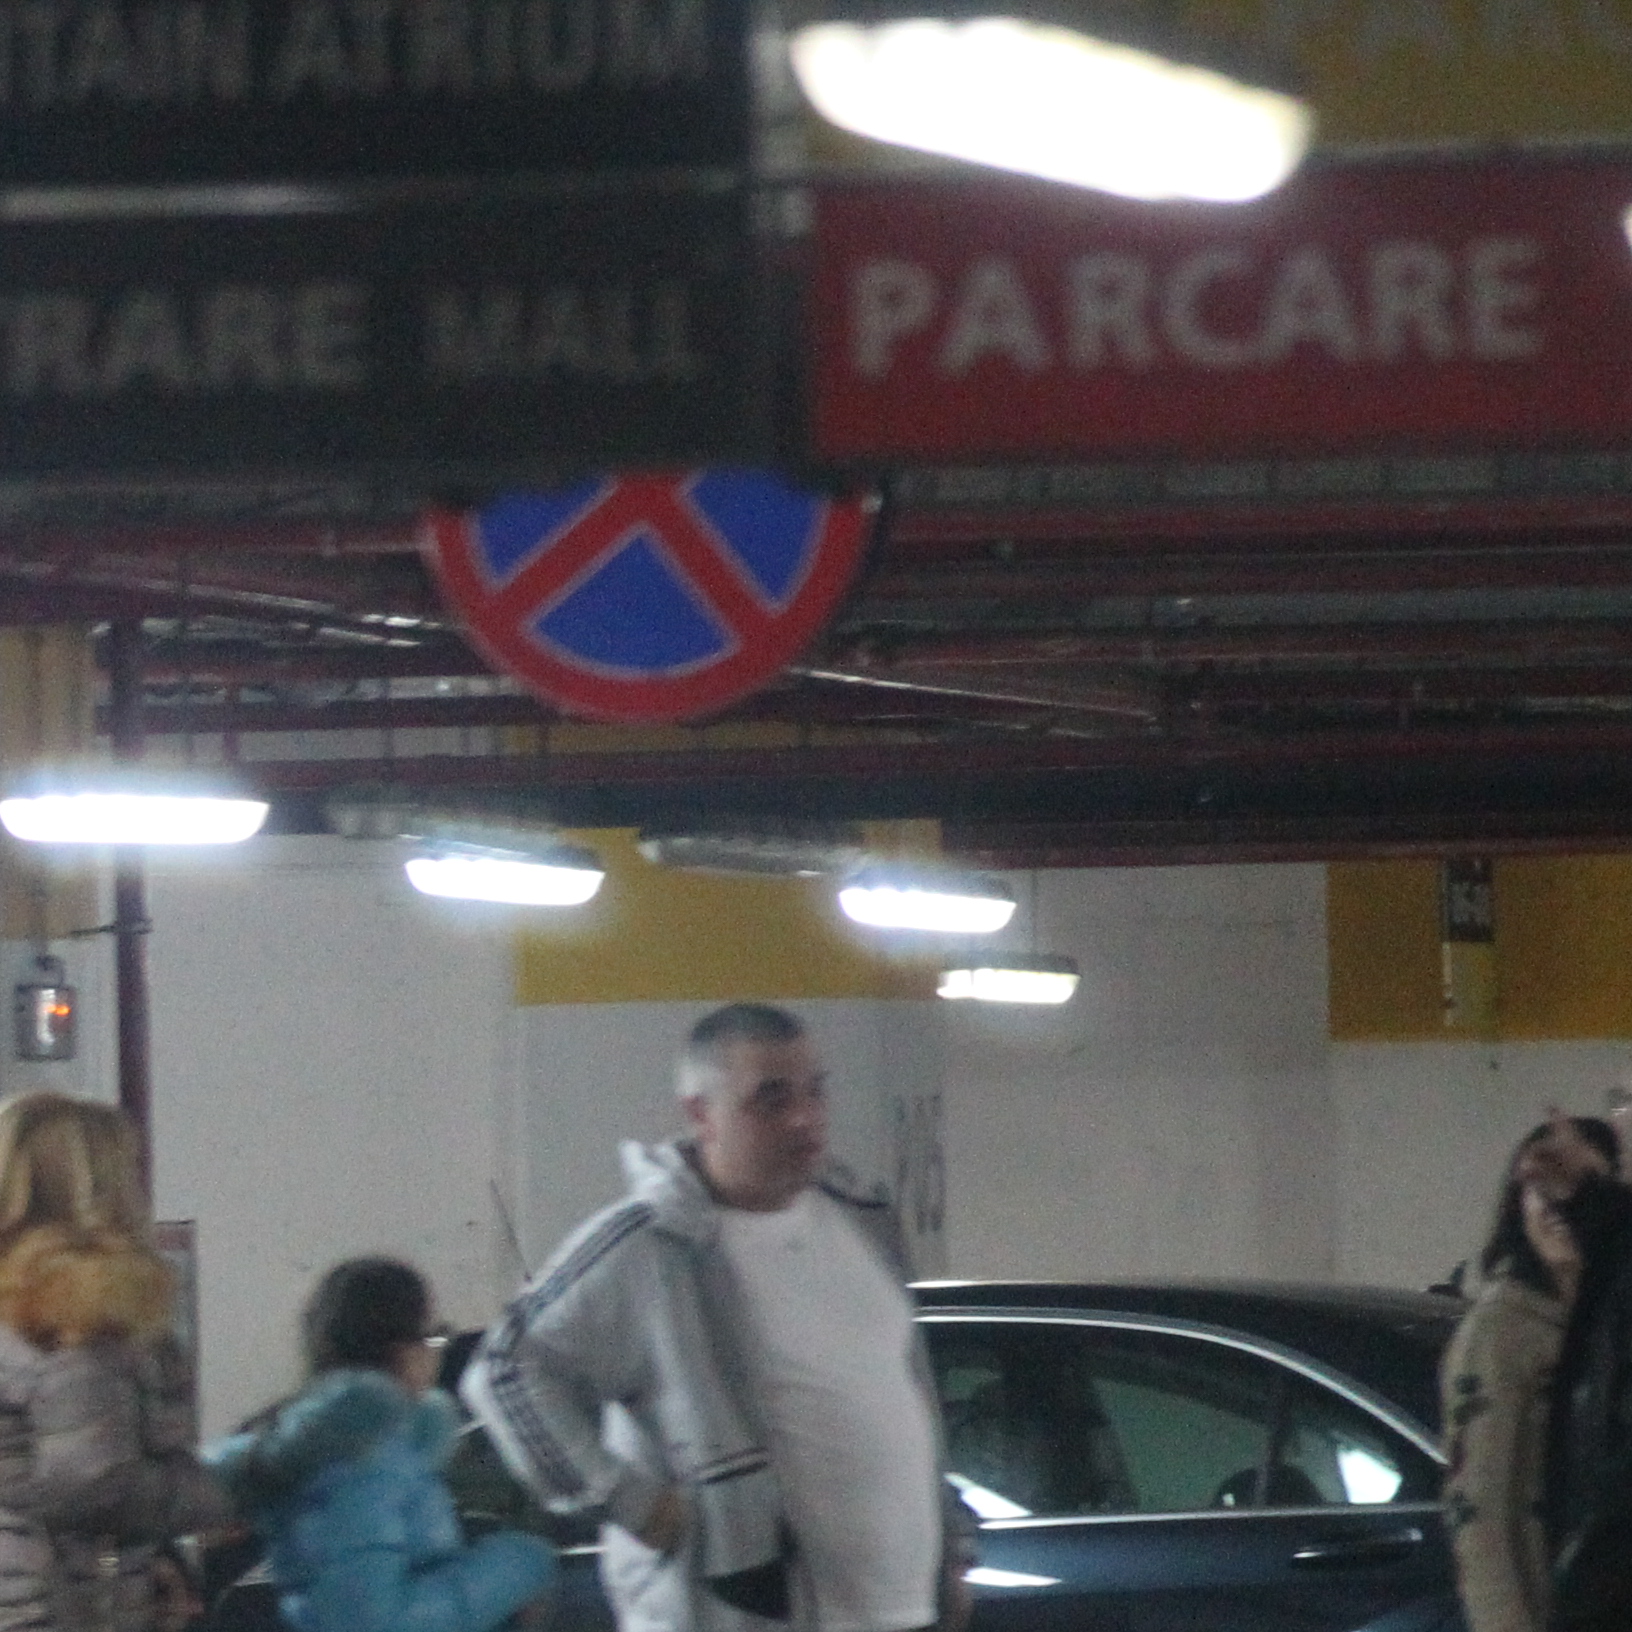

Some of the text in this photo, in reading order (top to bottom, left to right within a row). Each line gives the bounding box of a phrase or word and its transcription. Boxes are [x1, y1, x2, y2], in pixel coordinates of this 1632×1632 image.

[272, 0, 712, 100] ATRIUM
[426, 282, 704, 388] MALL
[850, 232, 1544, 380] PARCARE
